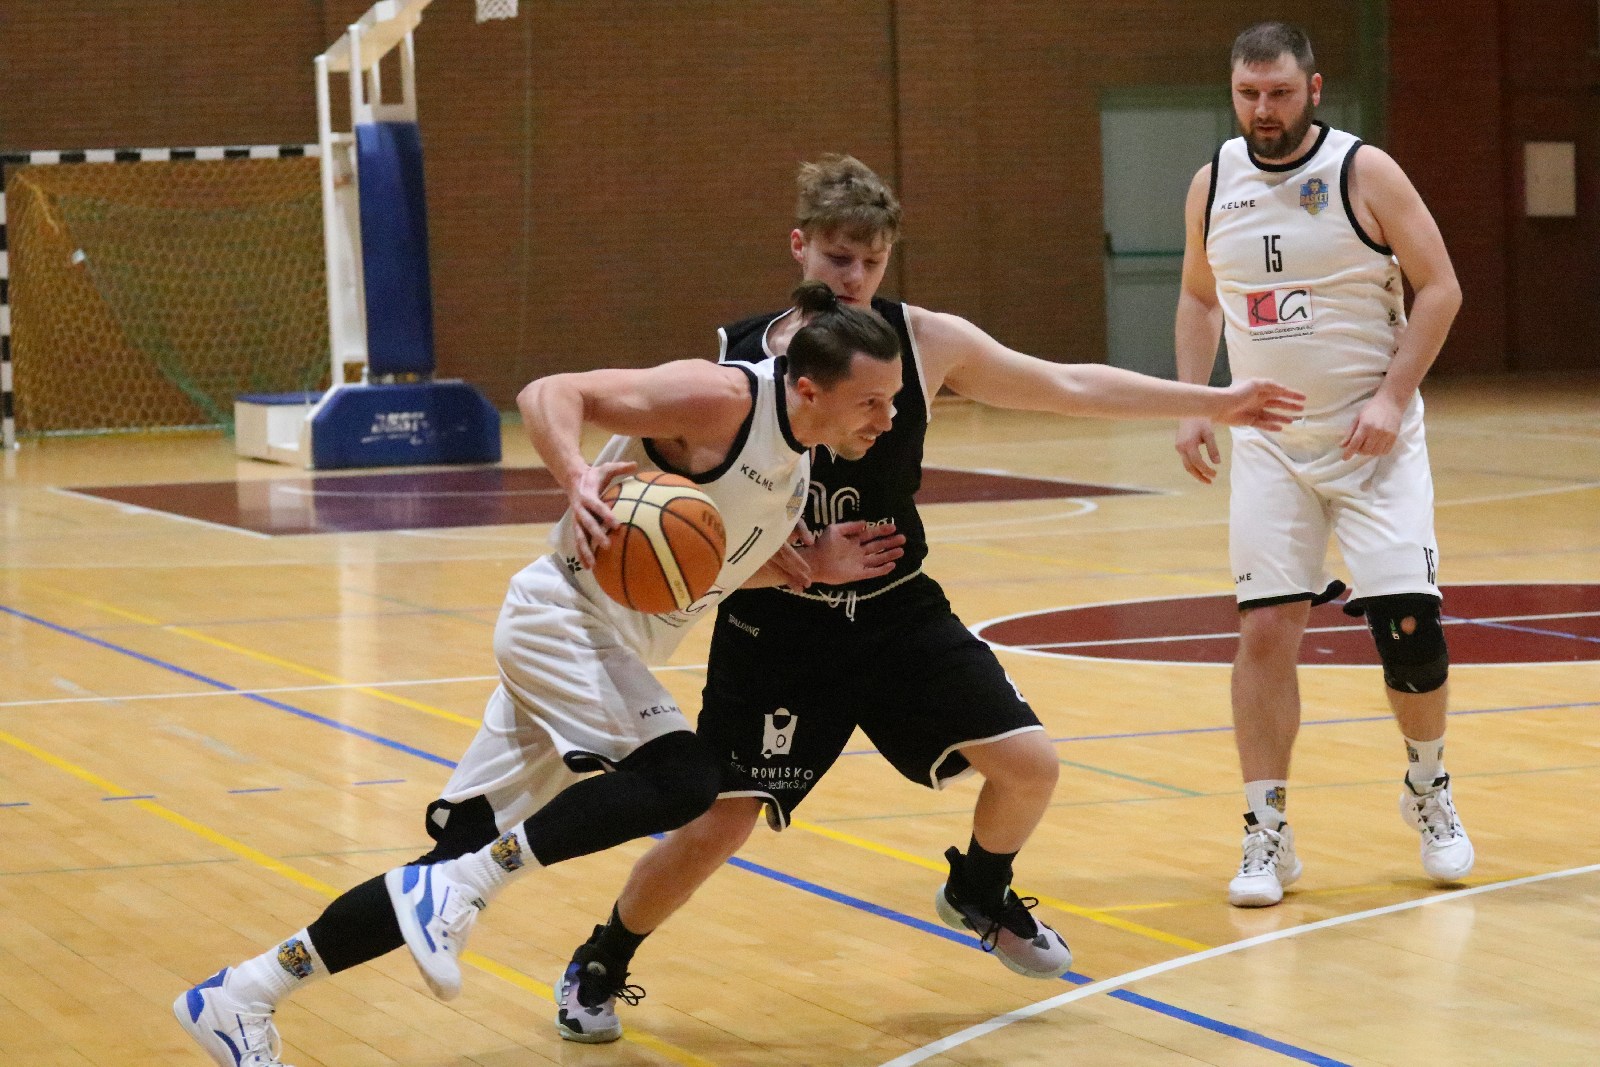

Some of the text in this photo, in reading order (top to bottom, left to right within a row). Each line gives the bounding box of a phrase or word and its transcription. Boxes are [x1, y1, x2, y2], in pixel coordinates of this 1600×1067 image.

[1220, 199, 1256, 210] KELME
[1262, 234, 1283, 272] 15
[740, 463, 774, 491] KELME
[728, 613, 760, 637] SPALDING
